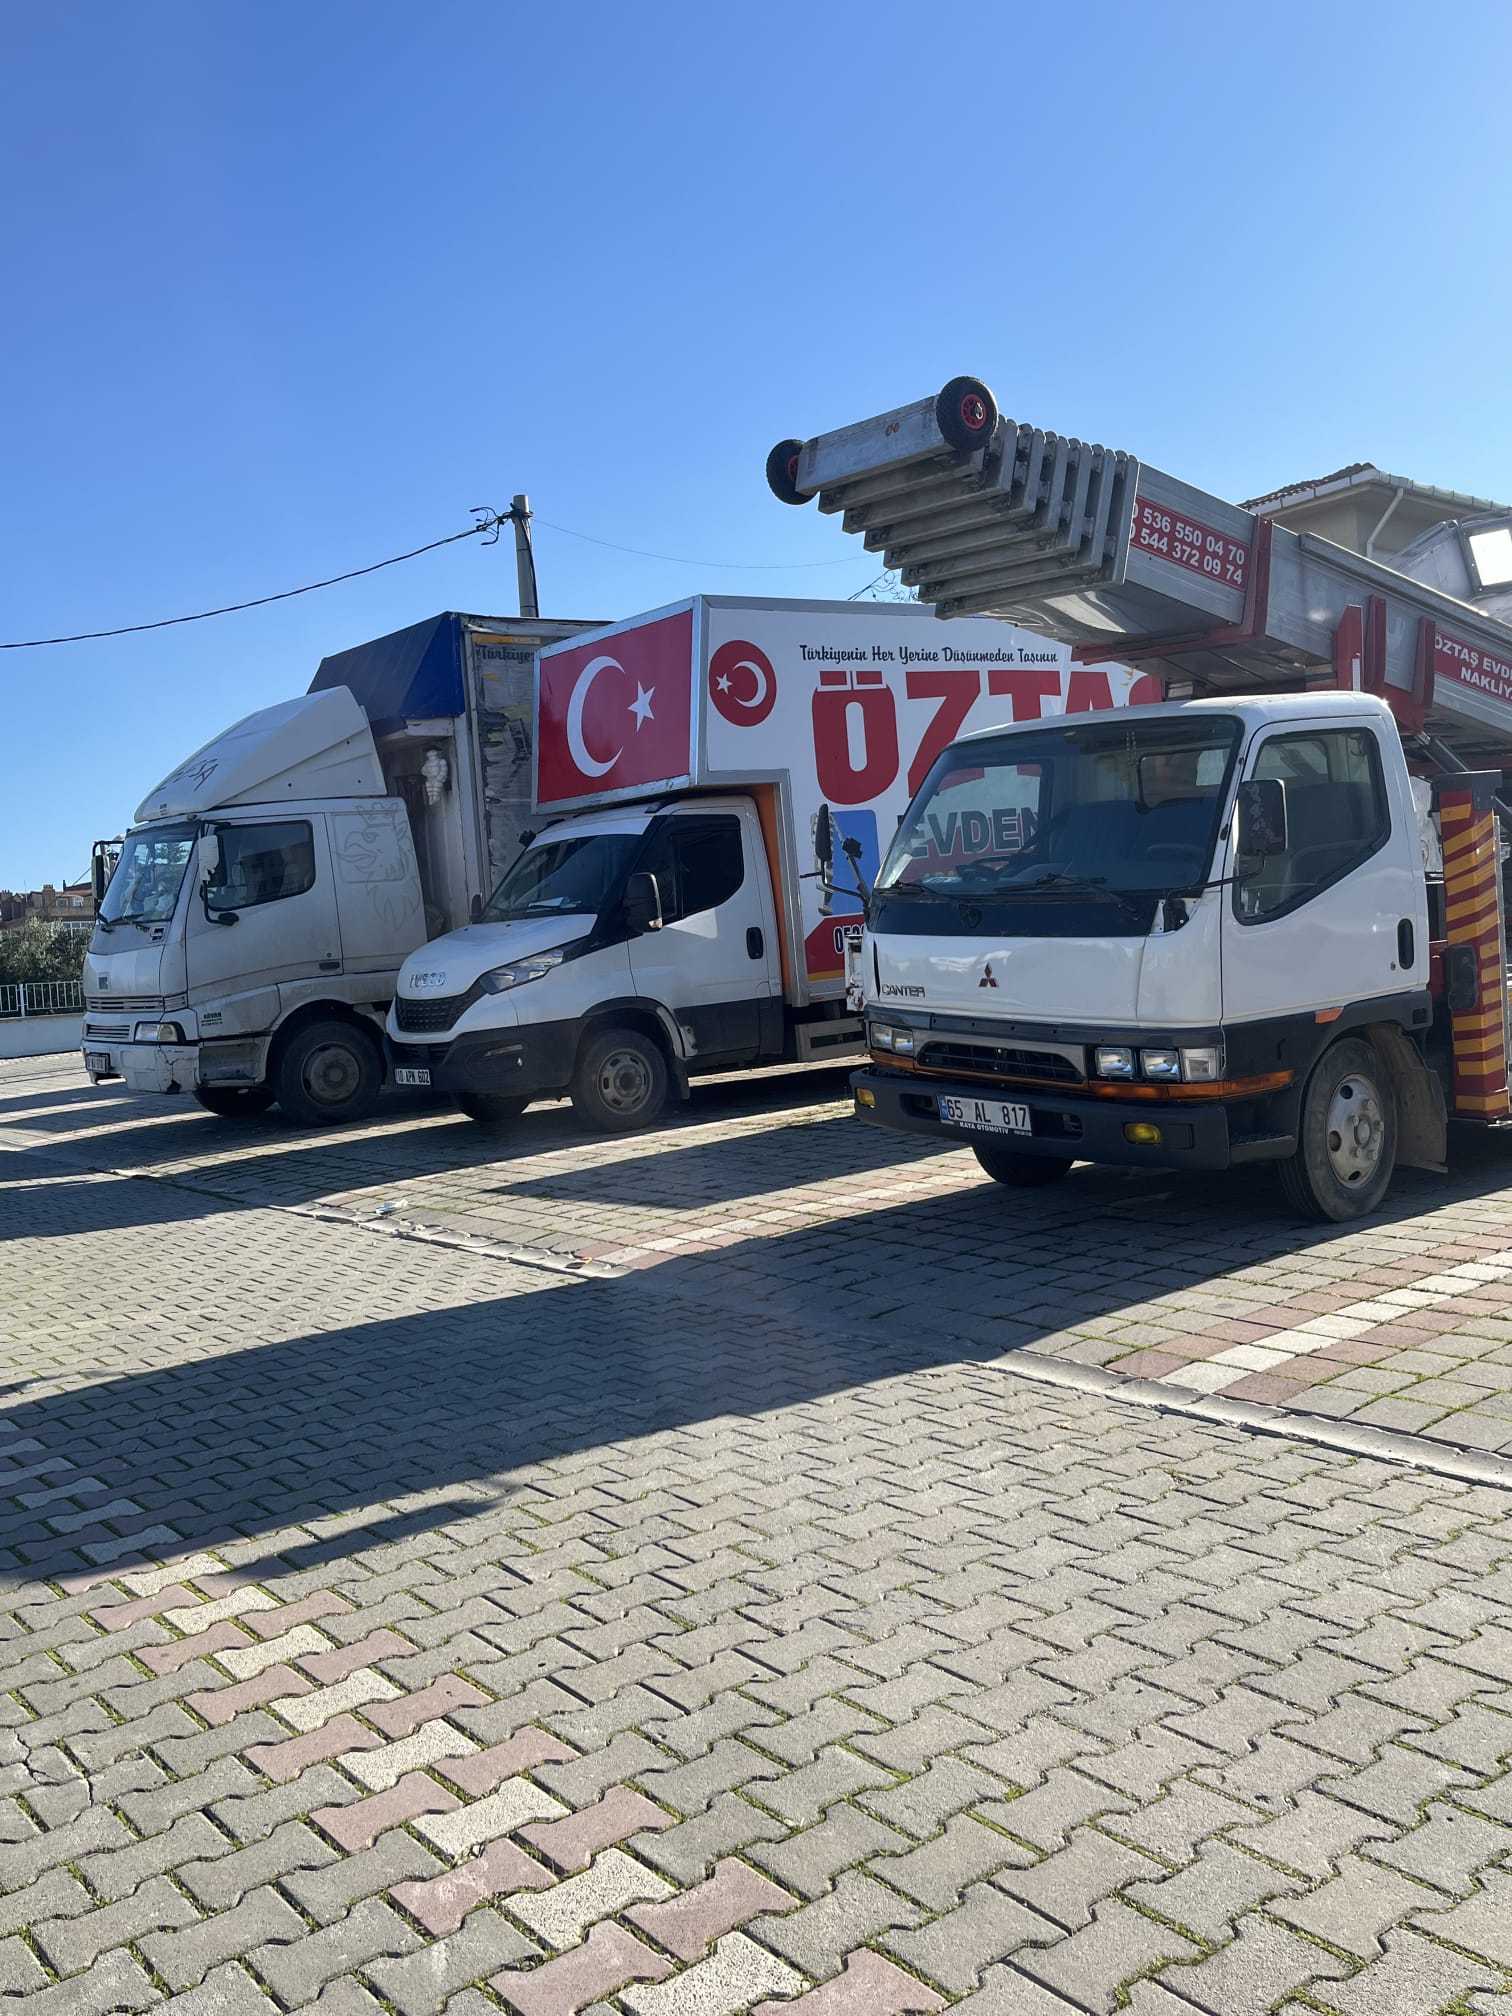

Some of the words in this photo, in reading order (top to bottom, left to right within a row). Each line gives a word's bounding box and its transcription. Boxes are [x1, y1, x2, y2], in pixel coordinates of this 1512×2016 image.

[1143, 507, 1171, 533] 536
[1175, 521, 1202, 547] 550
[1206, 536, 1224, 556] 04
[1228, 544, 1245, 565] 70
[1140, 527, 1168, 553] 544
[1172, 541, 1200, 567] 372
[1203, 555, 1221, 575] 09
[1226, 564, 1243, 585] 74
[800, 645, 867, 664] Türkiyenin
[871, 646, 896, 662] Her
[899, 646, 940, 665] Yerine
[942, 647, 1014, 664] Düşünmeden
[1017, 648, 1058, 664] Taşının
[1434, 633, 1479, 668] ÖZTAŞ
[1483, 657, 1512, 680] EVD
[1460, 666, 1512, 700] NAKLİY
[409, 971, 447, 989] IVECO
[881, 983, 926, 998] CANTER
[947, 1099, 963, 1119] 65
[974, 1102, 991, 1123] AL
[1001, 1105, 1026, 1128] 817
